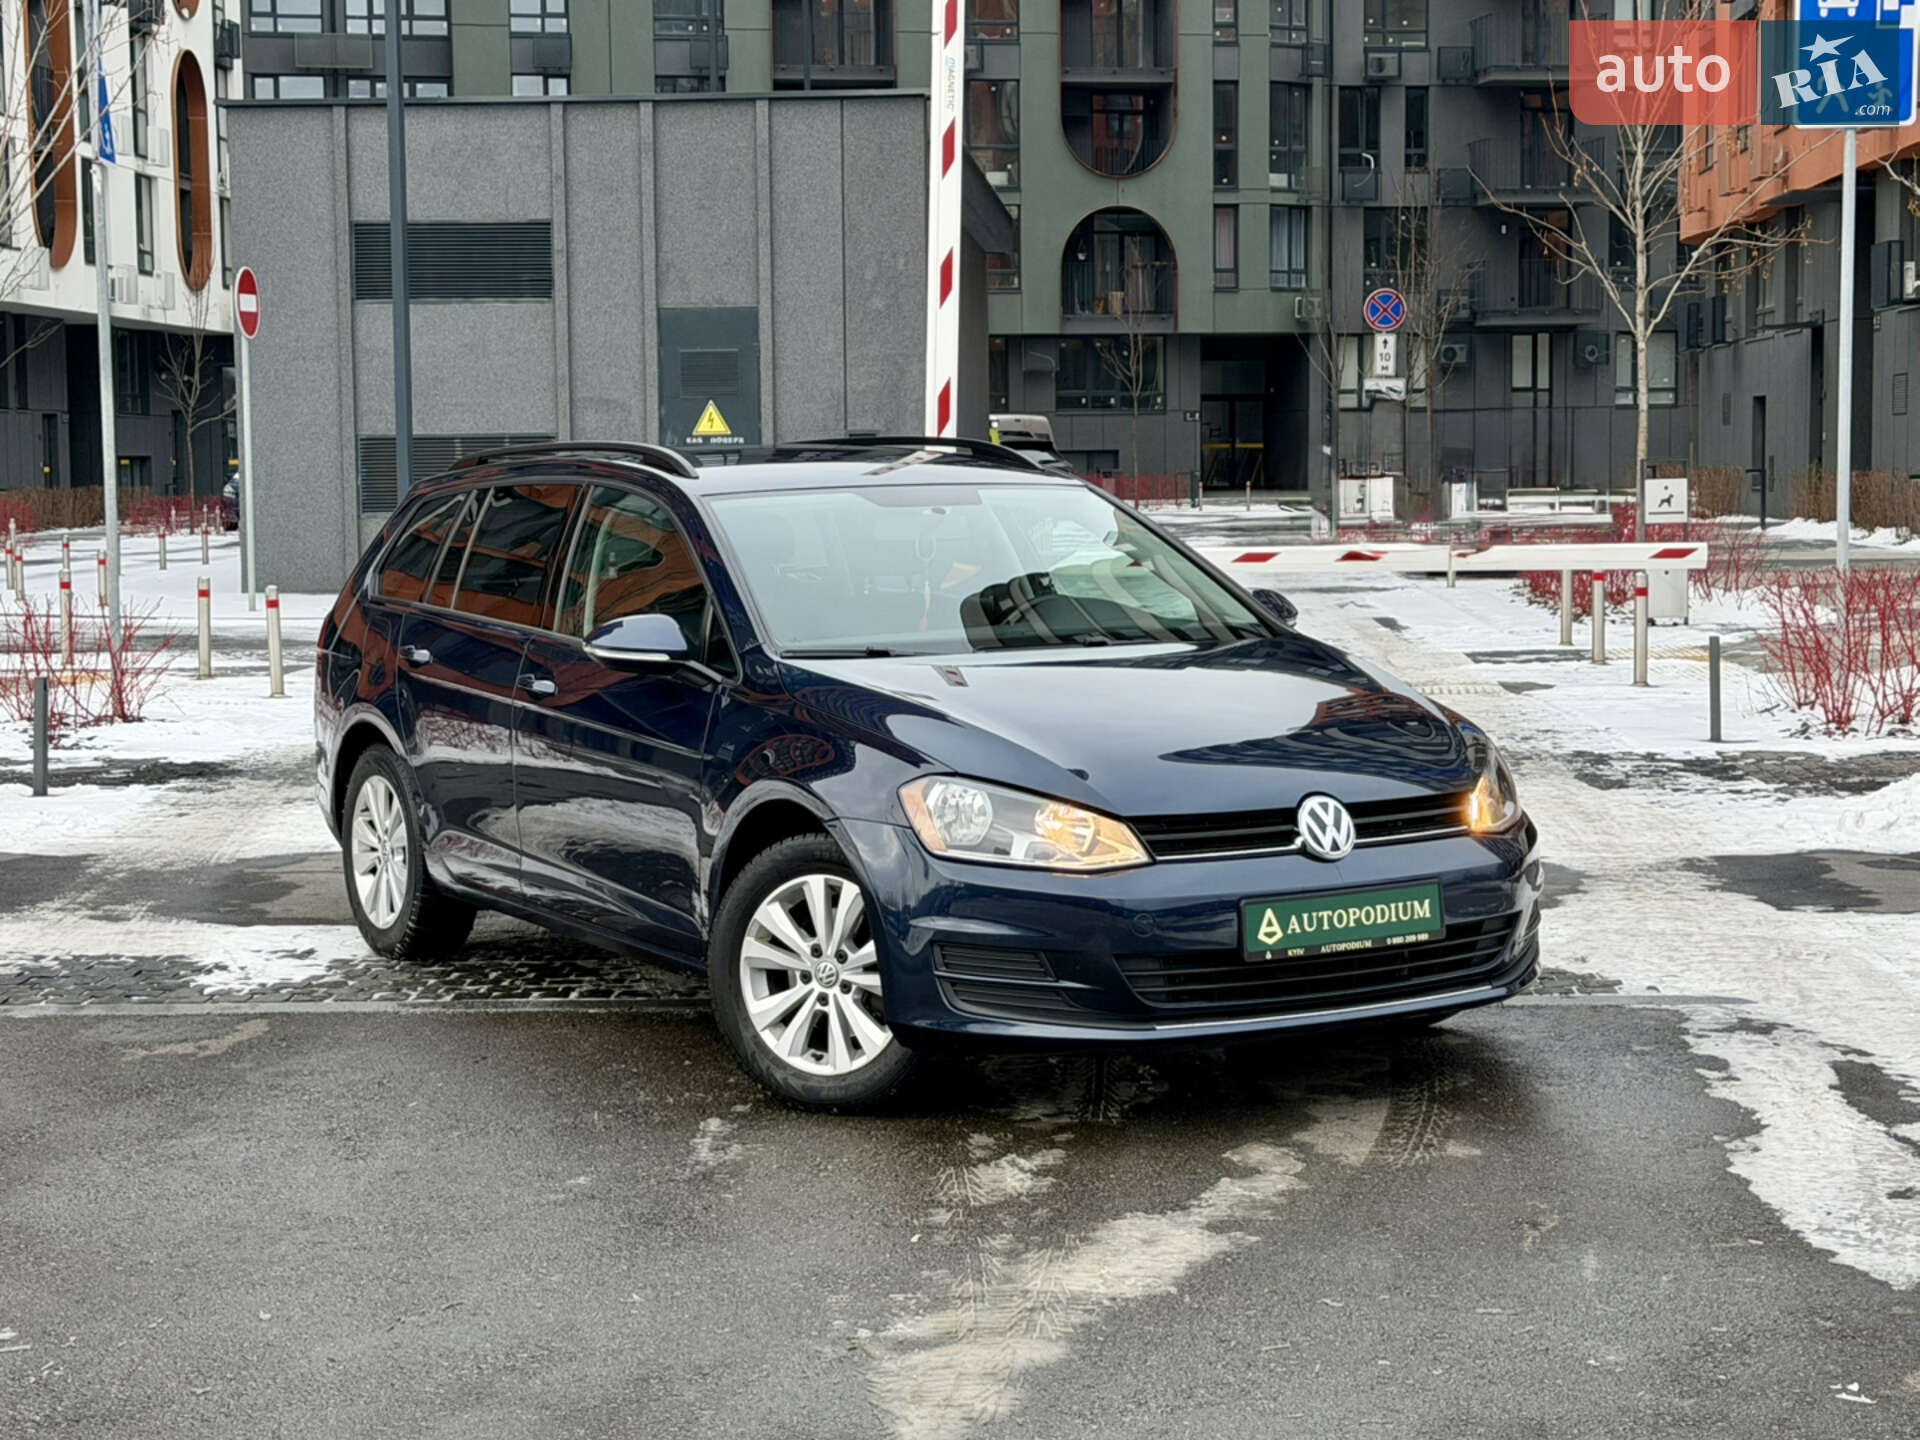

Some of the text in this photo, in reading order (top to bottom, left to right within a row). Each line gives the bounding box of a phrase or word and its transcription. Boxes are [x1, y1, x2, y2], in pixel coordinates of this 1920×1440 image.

[1379, 352, 1391, 362] 10
[1299, 796, 1355, 856] VW
[1287, 899, 1432, 934] AUTOPODIUM
[1320, 939, 1372, 953] AUTOPODIUM
